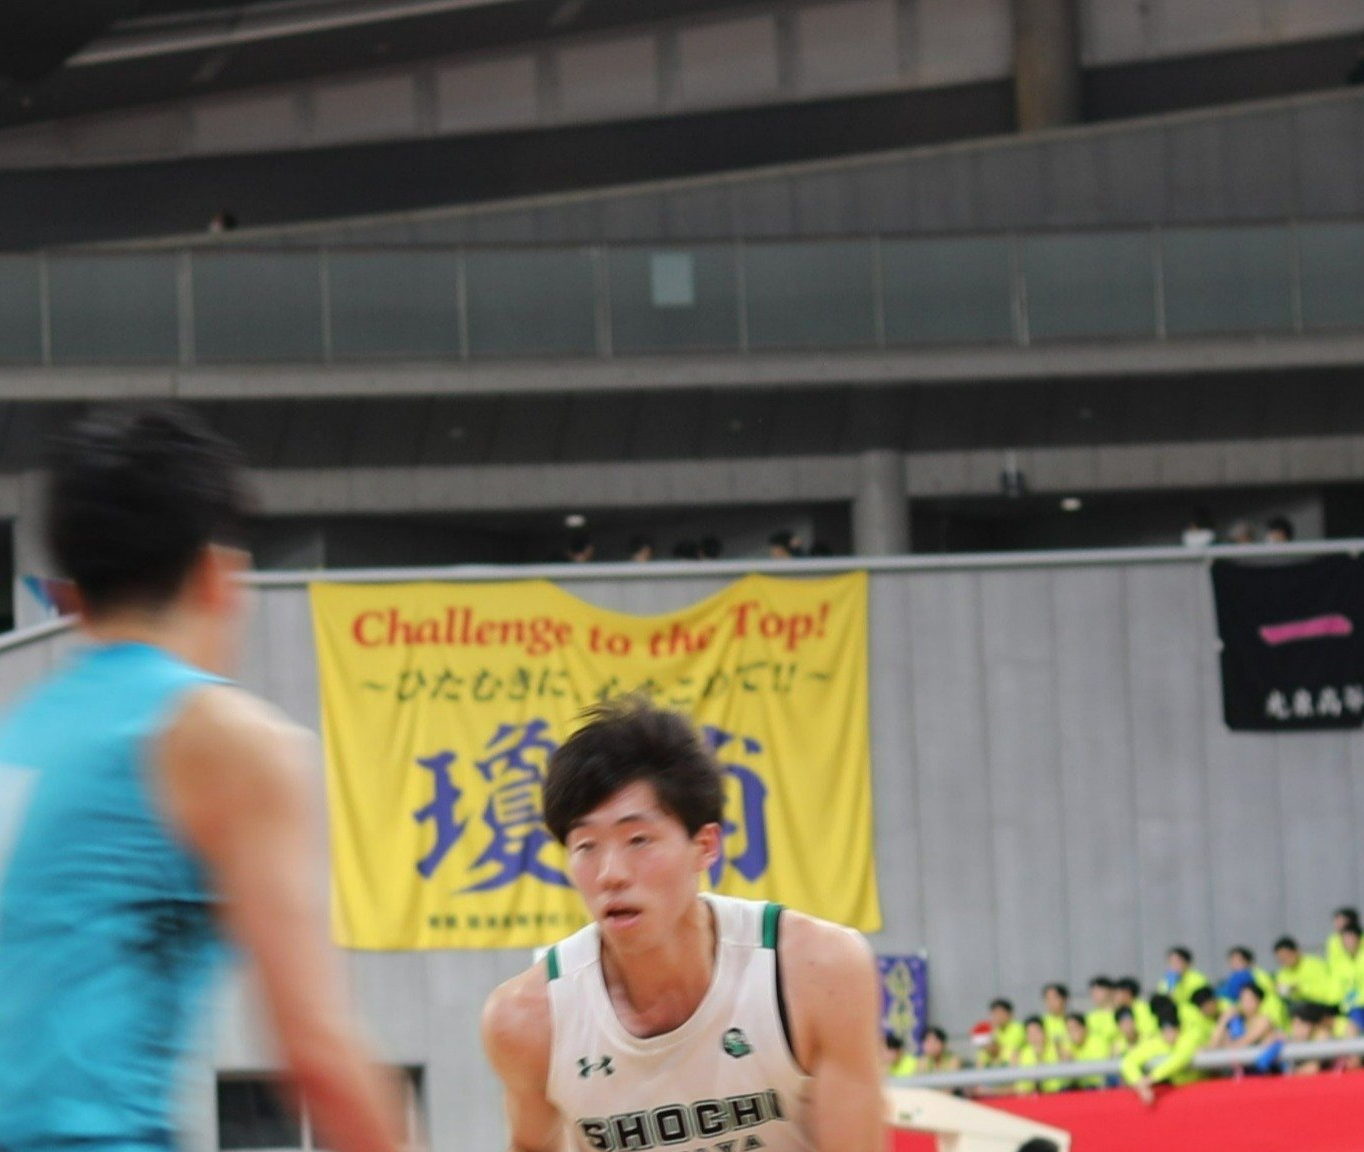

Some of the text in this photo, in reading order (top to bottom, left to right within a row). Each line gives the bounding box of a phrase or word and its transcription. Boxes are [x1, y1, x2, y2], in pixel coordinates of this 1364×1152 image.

[352, 600, 832, 659] Challenge to the Top!
